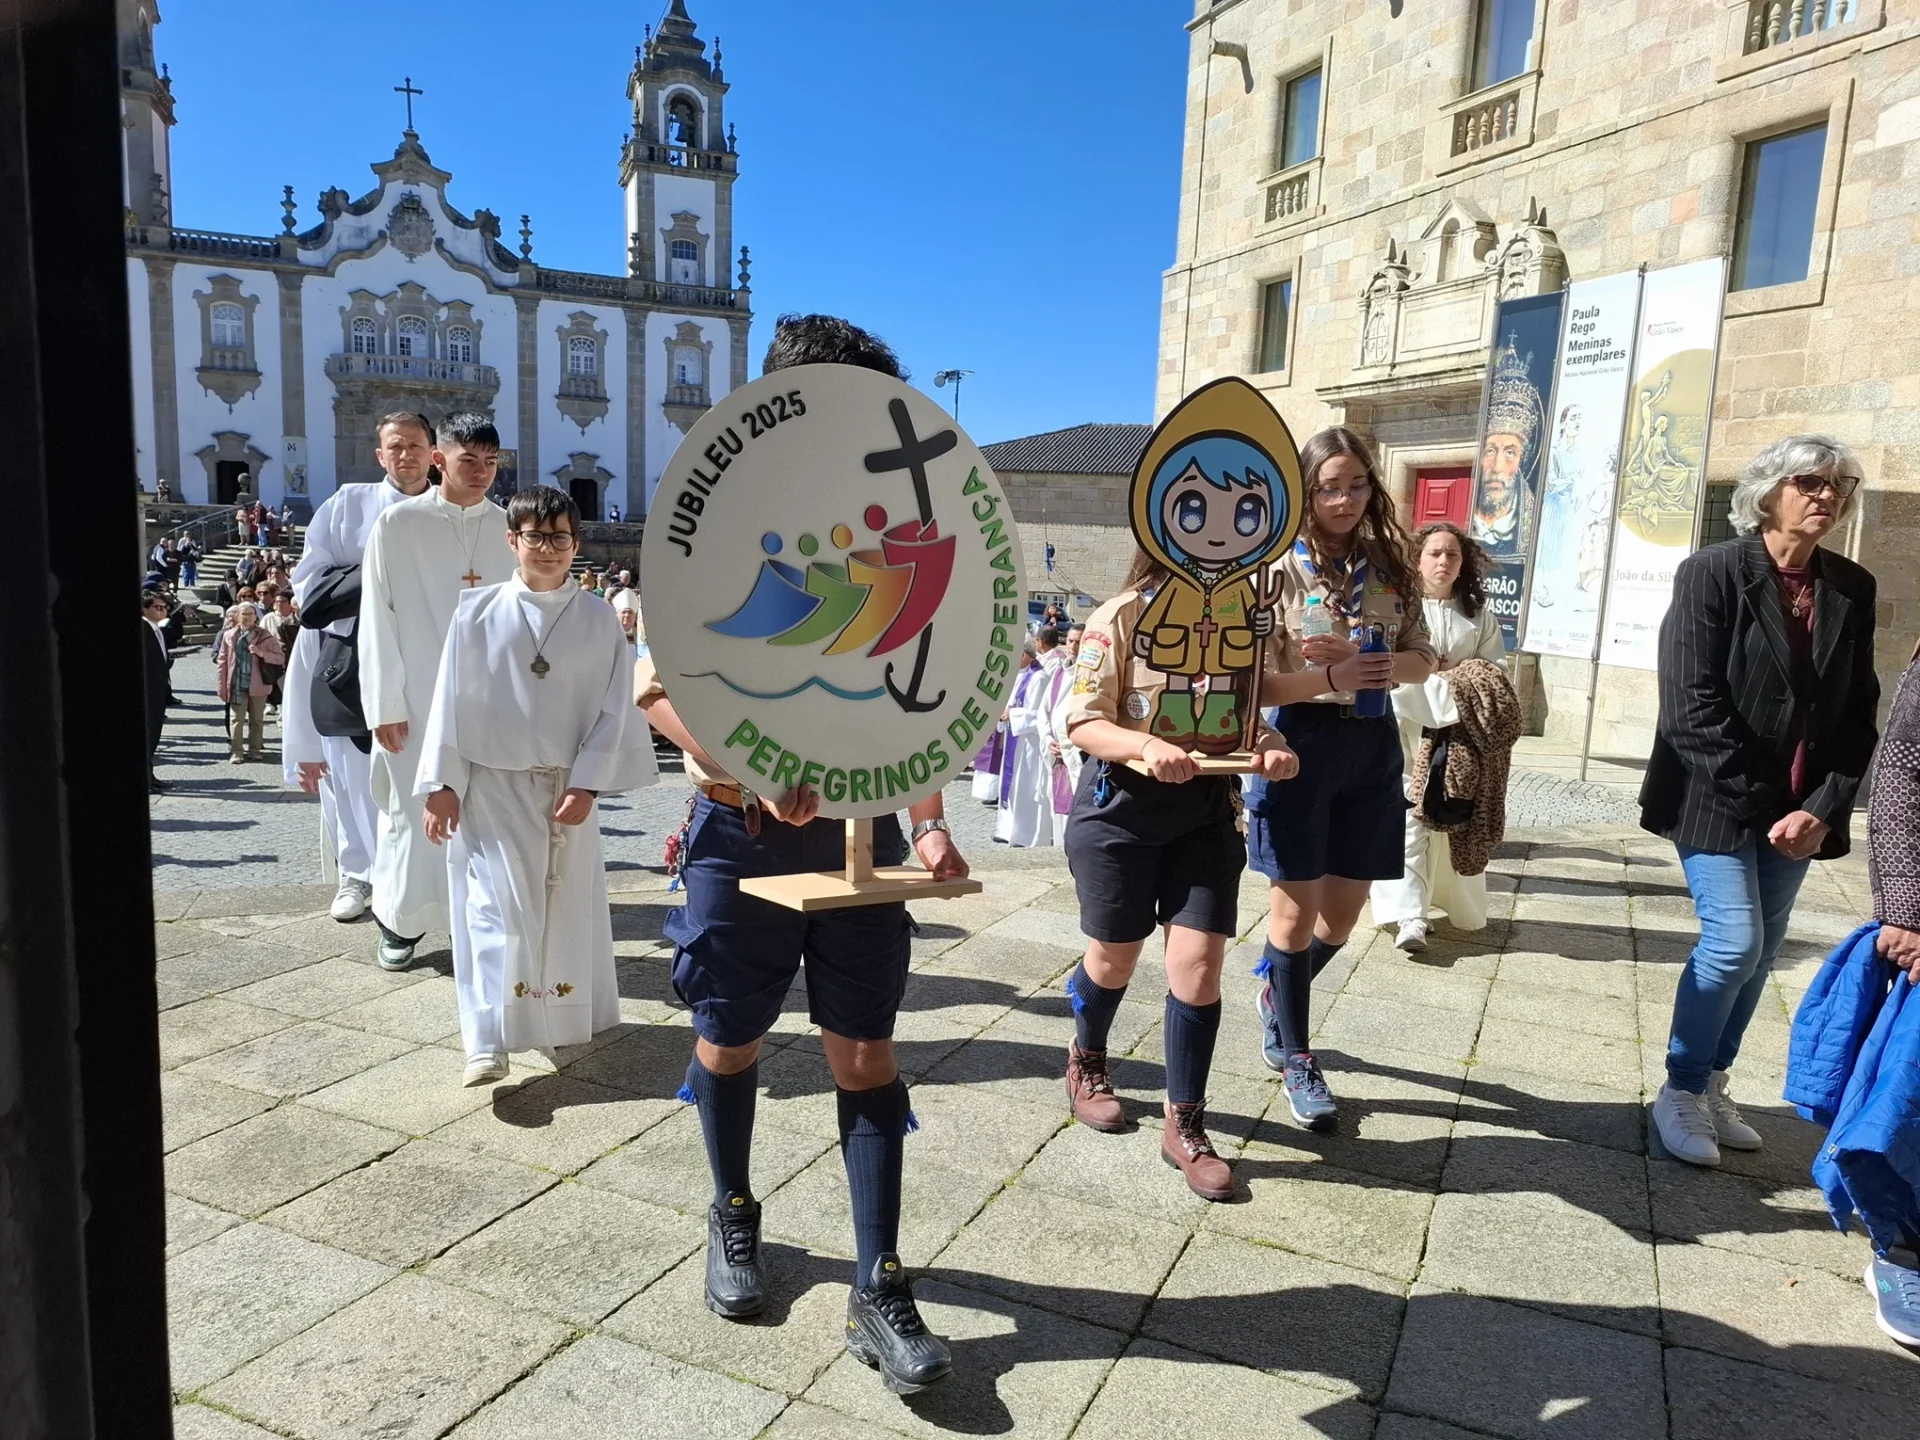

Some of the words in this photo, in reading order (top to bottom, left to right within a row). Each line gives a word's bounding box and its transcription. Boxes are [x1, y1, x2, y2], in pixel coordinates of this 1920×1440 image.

[1571, 305, 1601, 321] Paula
[1570, 322, 1596, 336] Rego
[1567, 336, 1612, 353] Meninas
[1565, 348, 1627, 367] exemplares
[668, 427, 744, 558] JUBILEU
[741, 390, 807, 440] 2025
[962, 465, 1019, 702] ESPERANÇA
[1483, 575, 1517, 596] GRÃO
[1614, 569, 1638, 582] João
[1641, 570, 1655, 582] da
[947, 696, 990, 752] DE
[725, 718, 951, 804] PEREGRINOS
